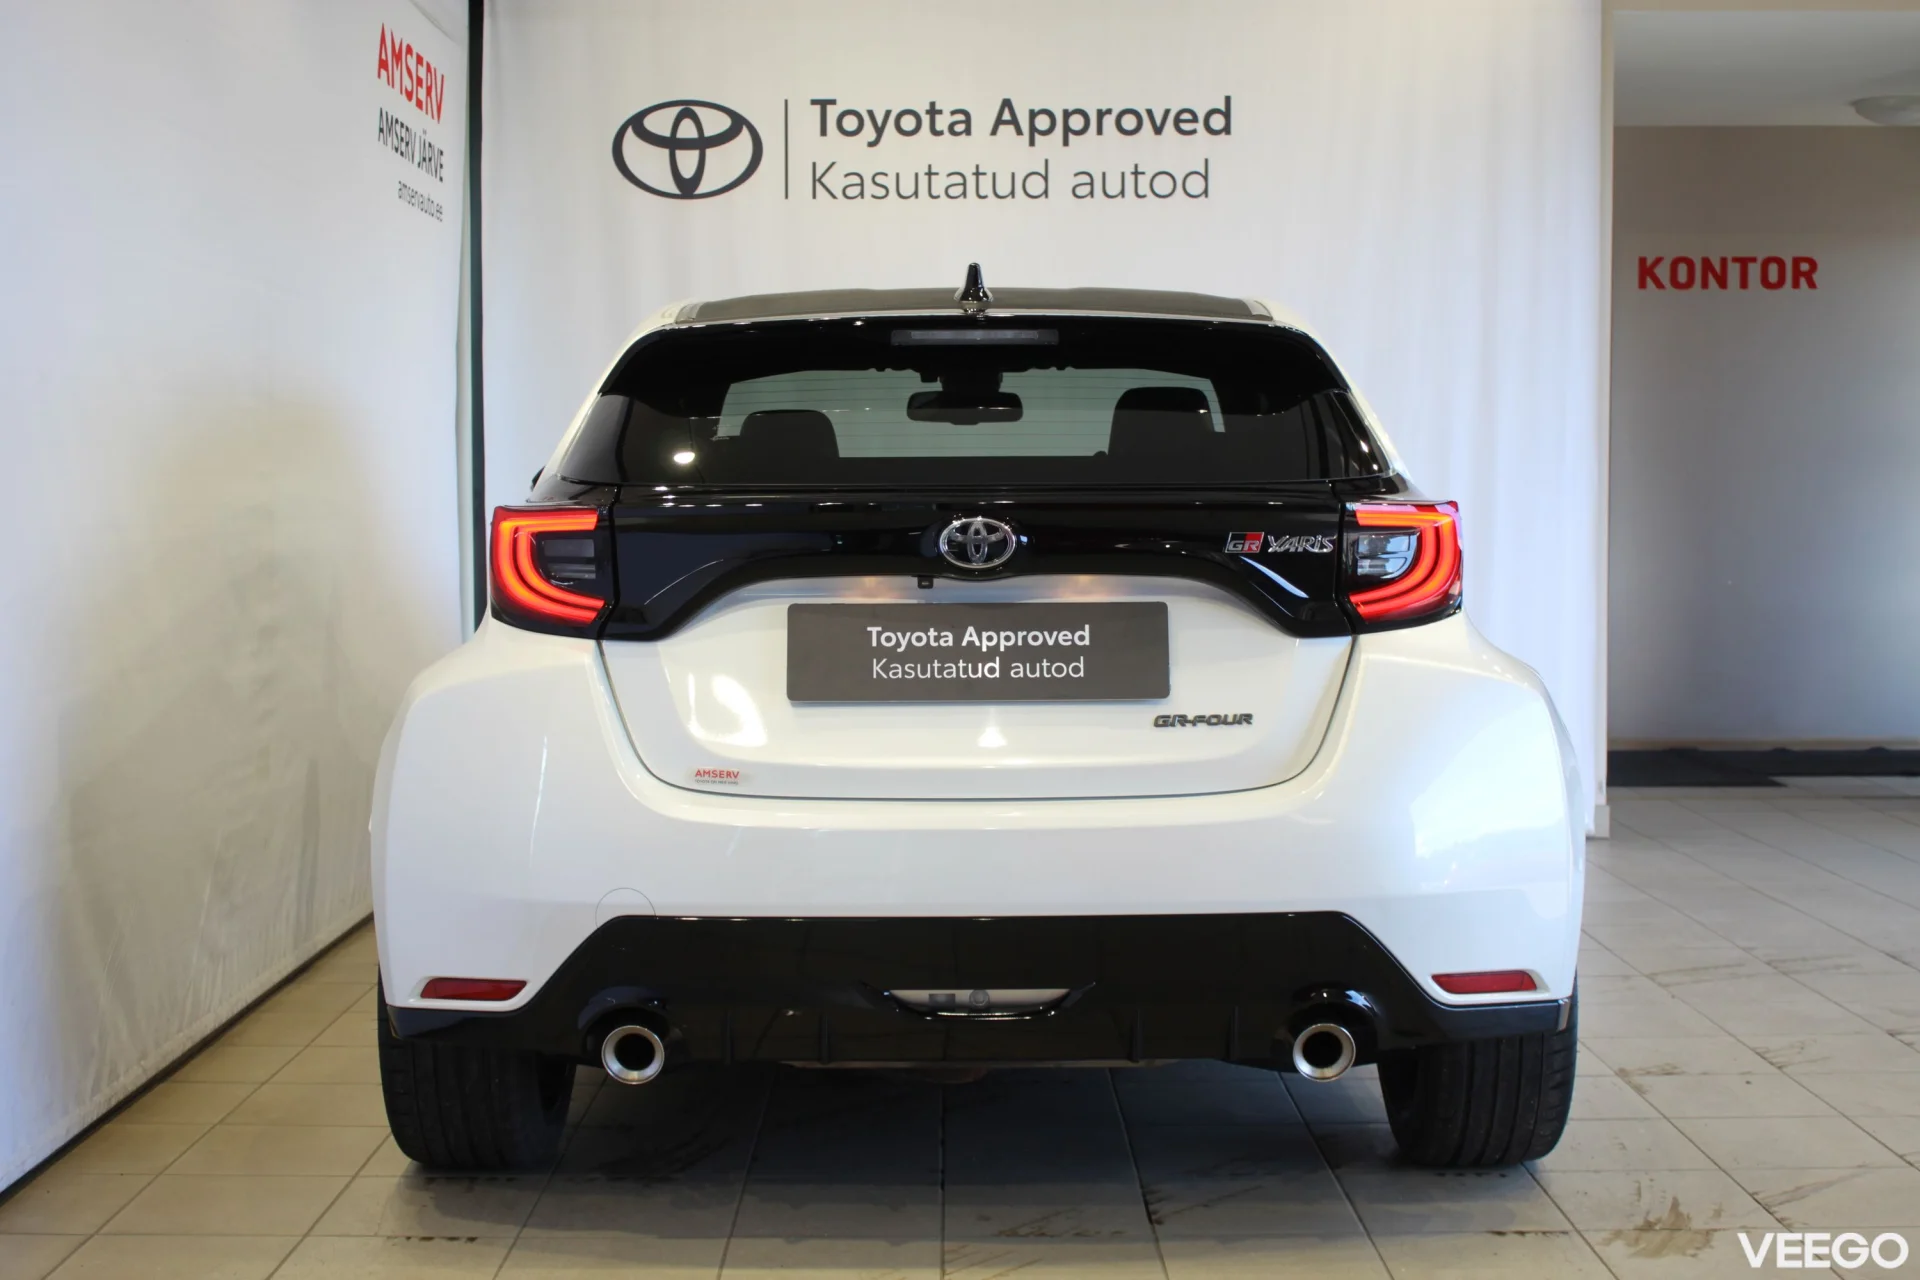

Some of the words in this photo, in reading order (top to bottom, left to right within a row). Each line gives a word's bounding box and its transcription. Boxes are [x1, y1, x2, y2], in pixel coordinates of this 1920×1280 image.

[377, 22, 445, 124] AMSERV
[810, 98, 973, 147] Toyota
[990, 95, 1233, 147] Approved
[378, 107, 417, 165] AMSERV
[417, 128, 444, 182] JÄRVE
[810, 158, 1050, 200] Kasutatud
[1071, 158, 1210, 200] autod
[1638, 256, 1819, 290] KONTOR
[867, 625, 954, 652] Toyota
[962, 624, 1091, 652] Approved
[872, 656, 1001, 679] Kasutatud
[1010, 656, 1085, 679] autod
[1154, 713, 1253, 728] GR-FOUR
[695, 769, 740, 779] AMSERV
